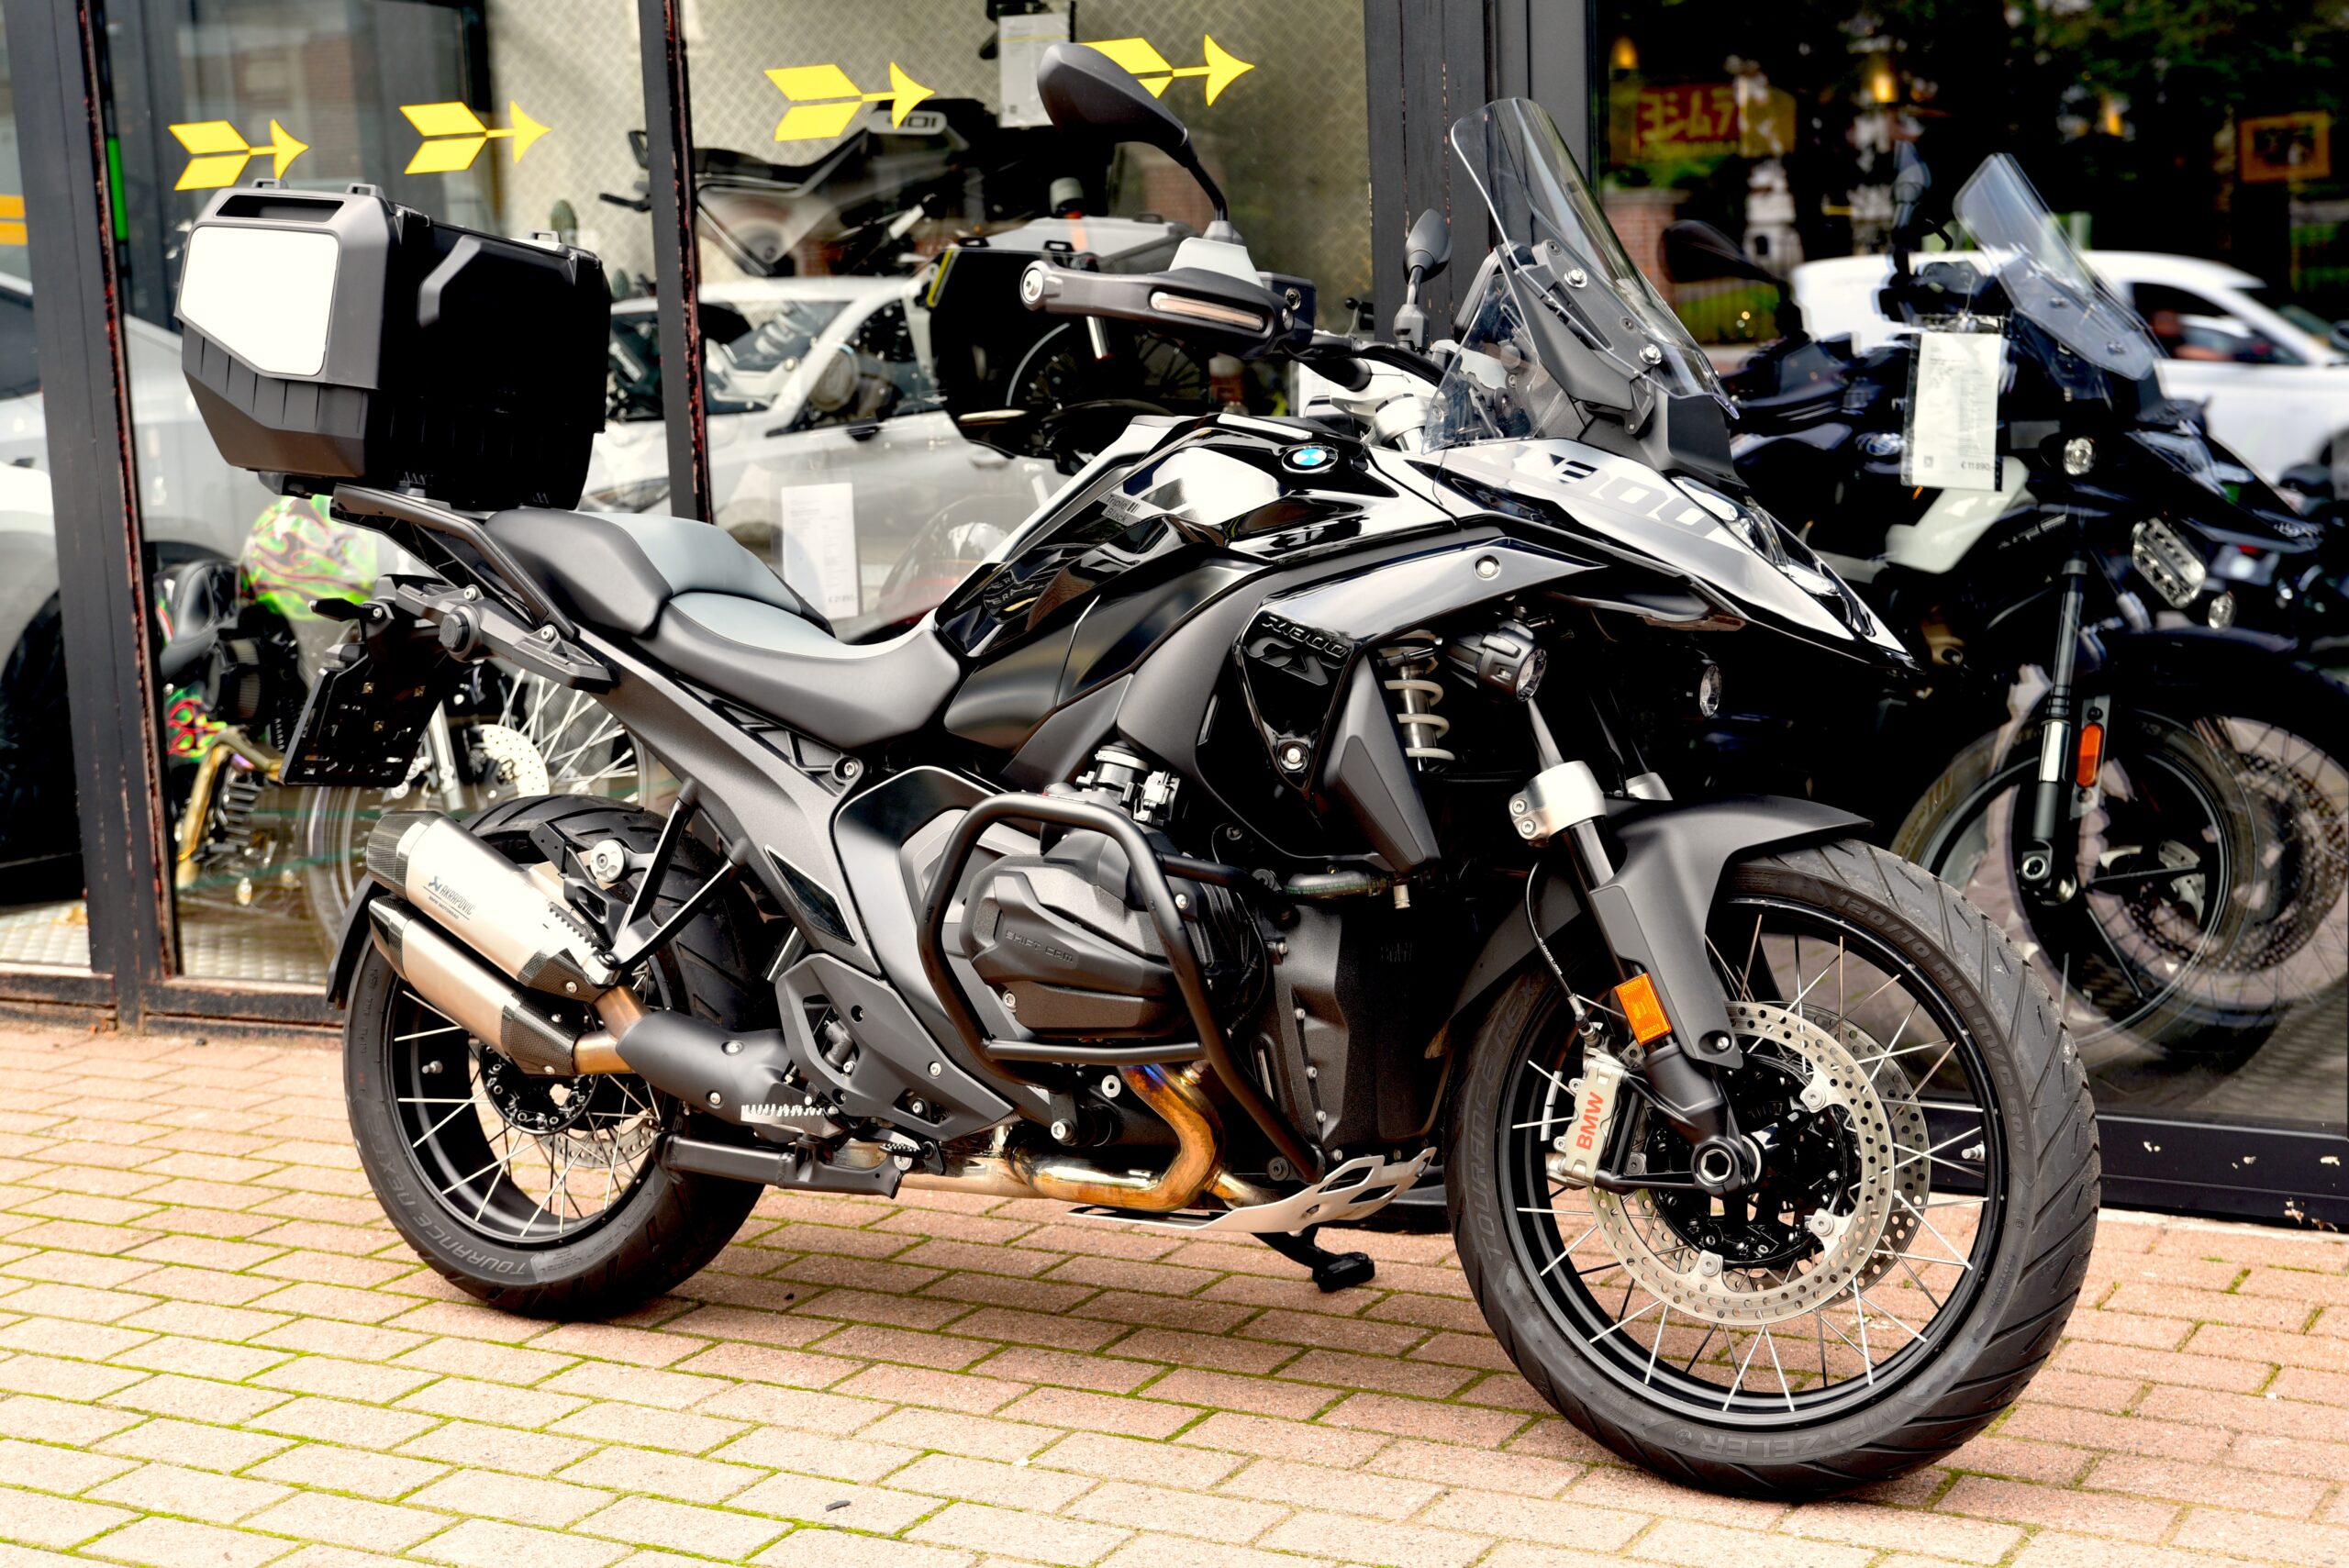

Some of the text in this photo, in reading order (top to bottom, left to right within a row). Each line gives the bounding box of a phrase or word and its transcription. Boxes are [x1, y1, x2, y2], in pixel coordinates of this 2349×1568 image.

[1106, 494, 1128, 510] Triple
[1105, 507, 1128, 523] Black
[1006, 930, 1041, 949] SHIFT
[1576, 1091, 1604, 1151] BMW
[412, 1212, 526, 1275] TOURANCE
